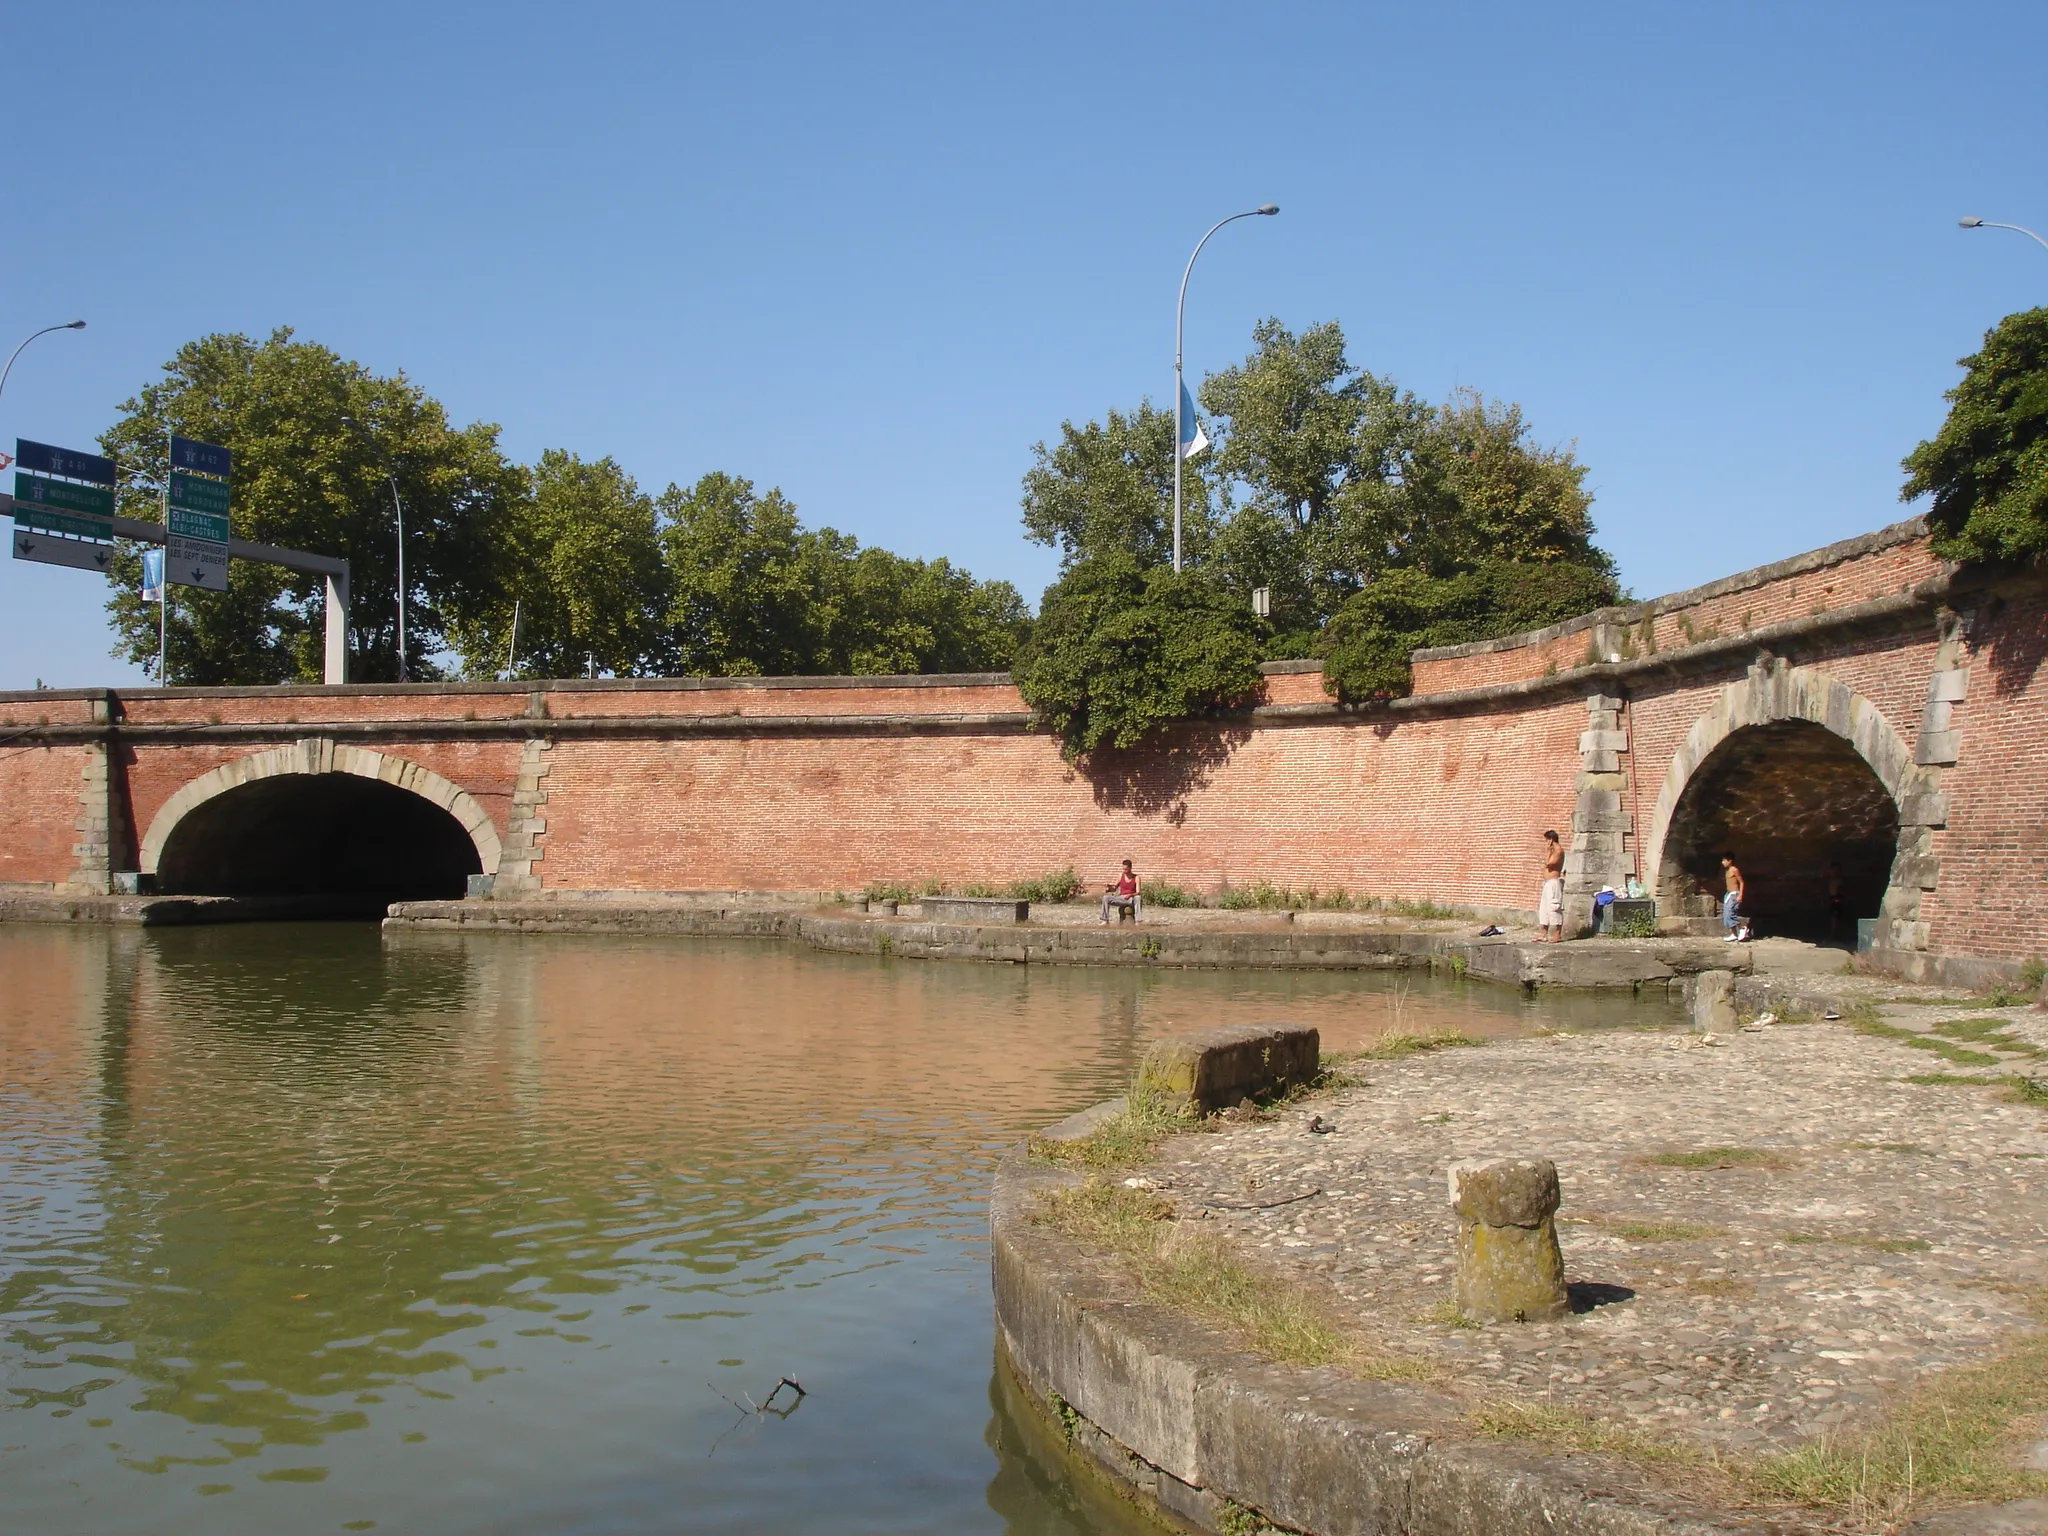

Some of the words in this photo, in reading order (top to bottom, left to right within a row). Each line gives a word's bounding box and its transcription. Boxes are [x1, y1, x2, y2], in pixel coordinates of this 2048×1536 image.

[49, 490, 100, 505] MONTPELLIER
[187, 494, 228, 511] BORDEAUX
[180, 512, 213, 528] BLAGNAC
[170, 538, 182, 548] LES
[184, 541, 227, 556] AMIDONNIERS
[170, 547, 182, 559] LES
[184, 550, 199, 562] SEPT
[200, 554, 226, 566] DENIERS
